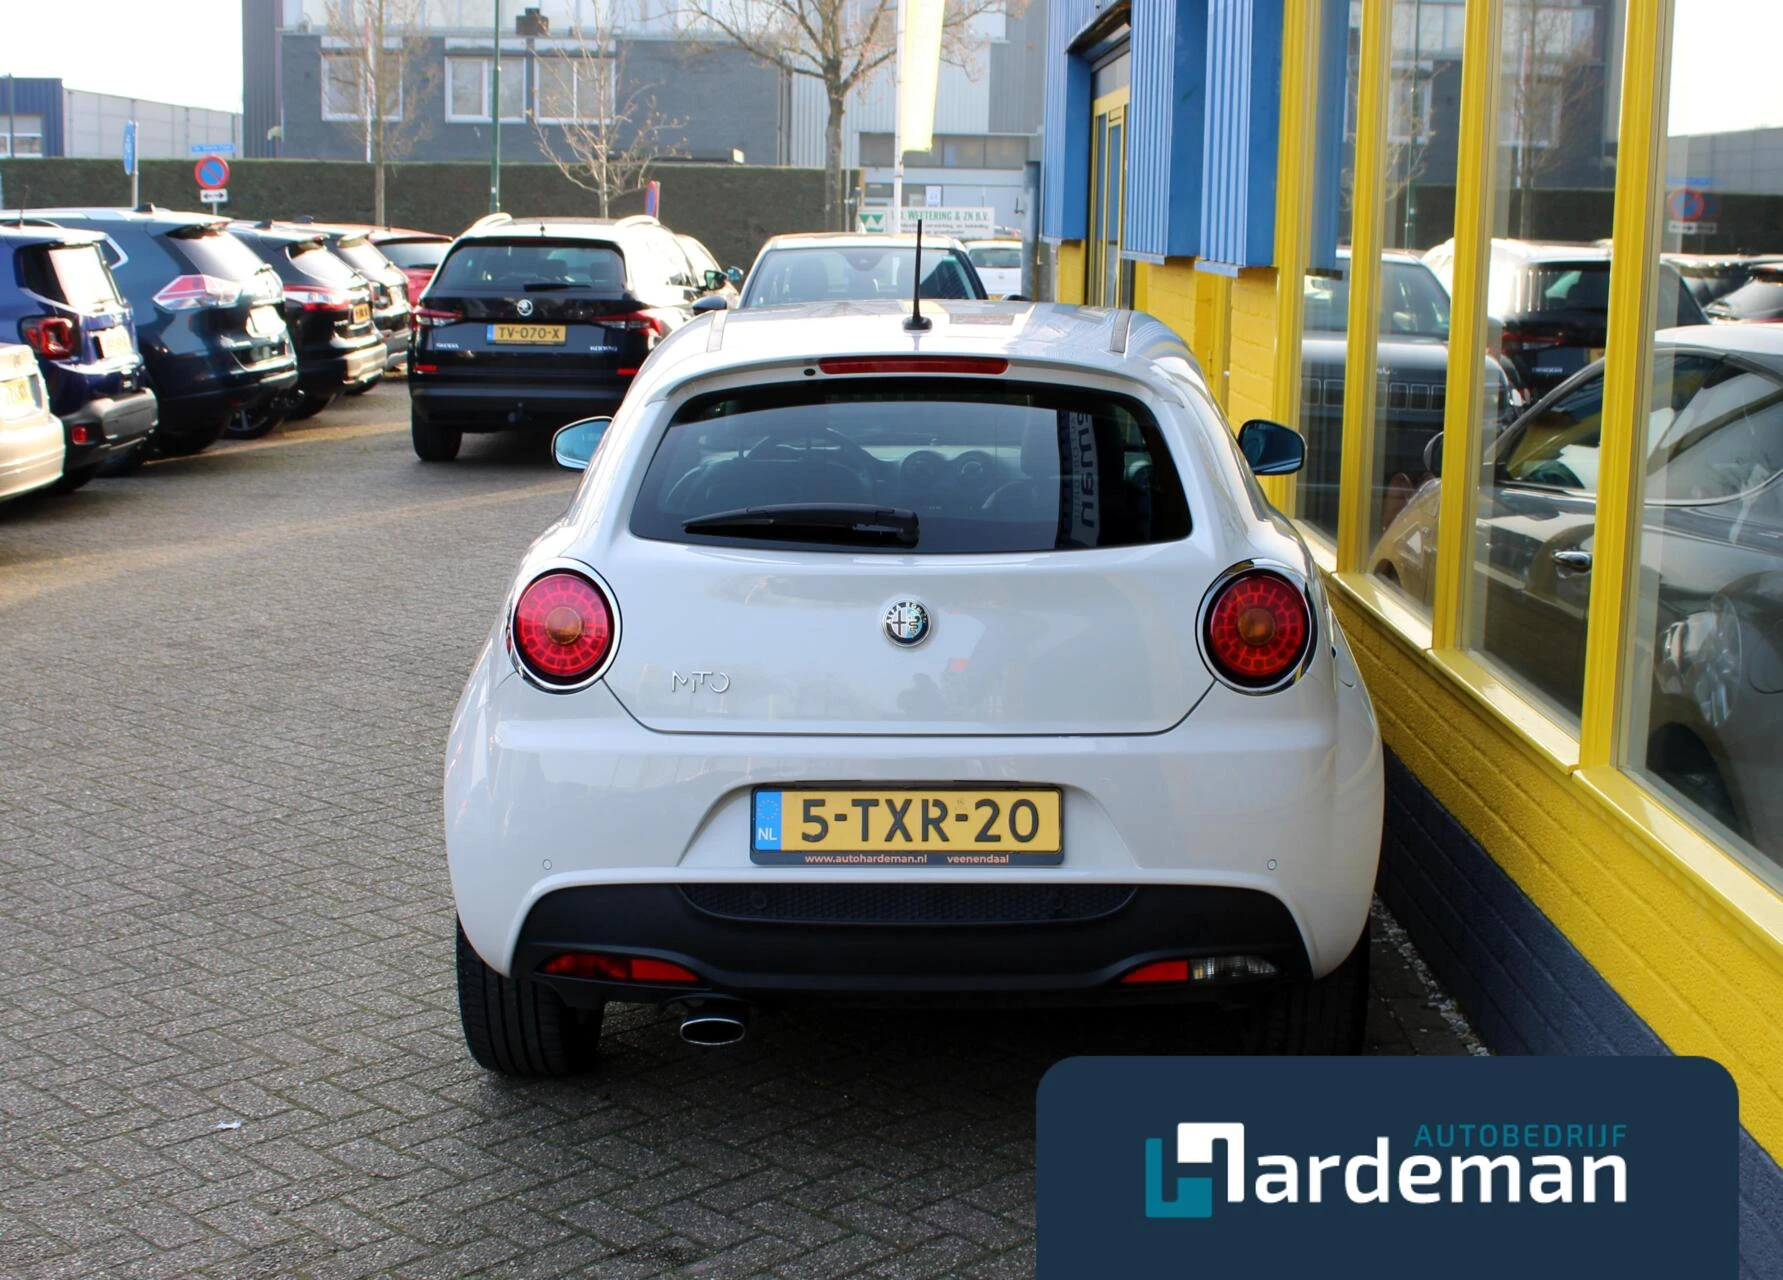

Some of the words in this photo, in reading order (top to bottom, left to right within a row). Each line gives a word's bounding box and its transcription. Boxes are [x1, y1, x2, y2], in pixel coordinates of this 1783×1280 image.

[499, 326, 560, 339] TV-070-X
[801, 798, 1040, 843] 5-TXR-20
[757, 827, 777, 841] NL
[804, 854, 928, 864] www.autohardeman.nl
[947, 854, 1010, 864] veenendaal
